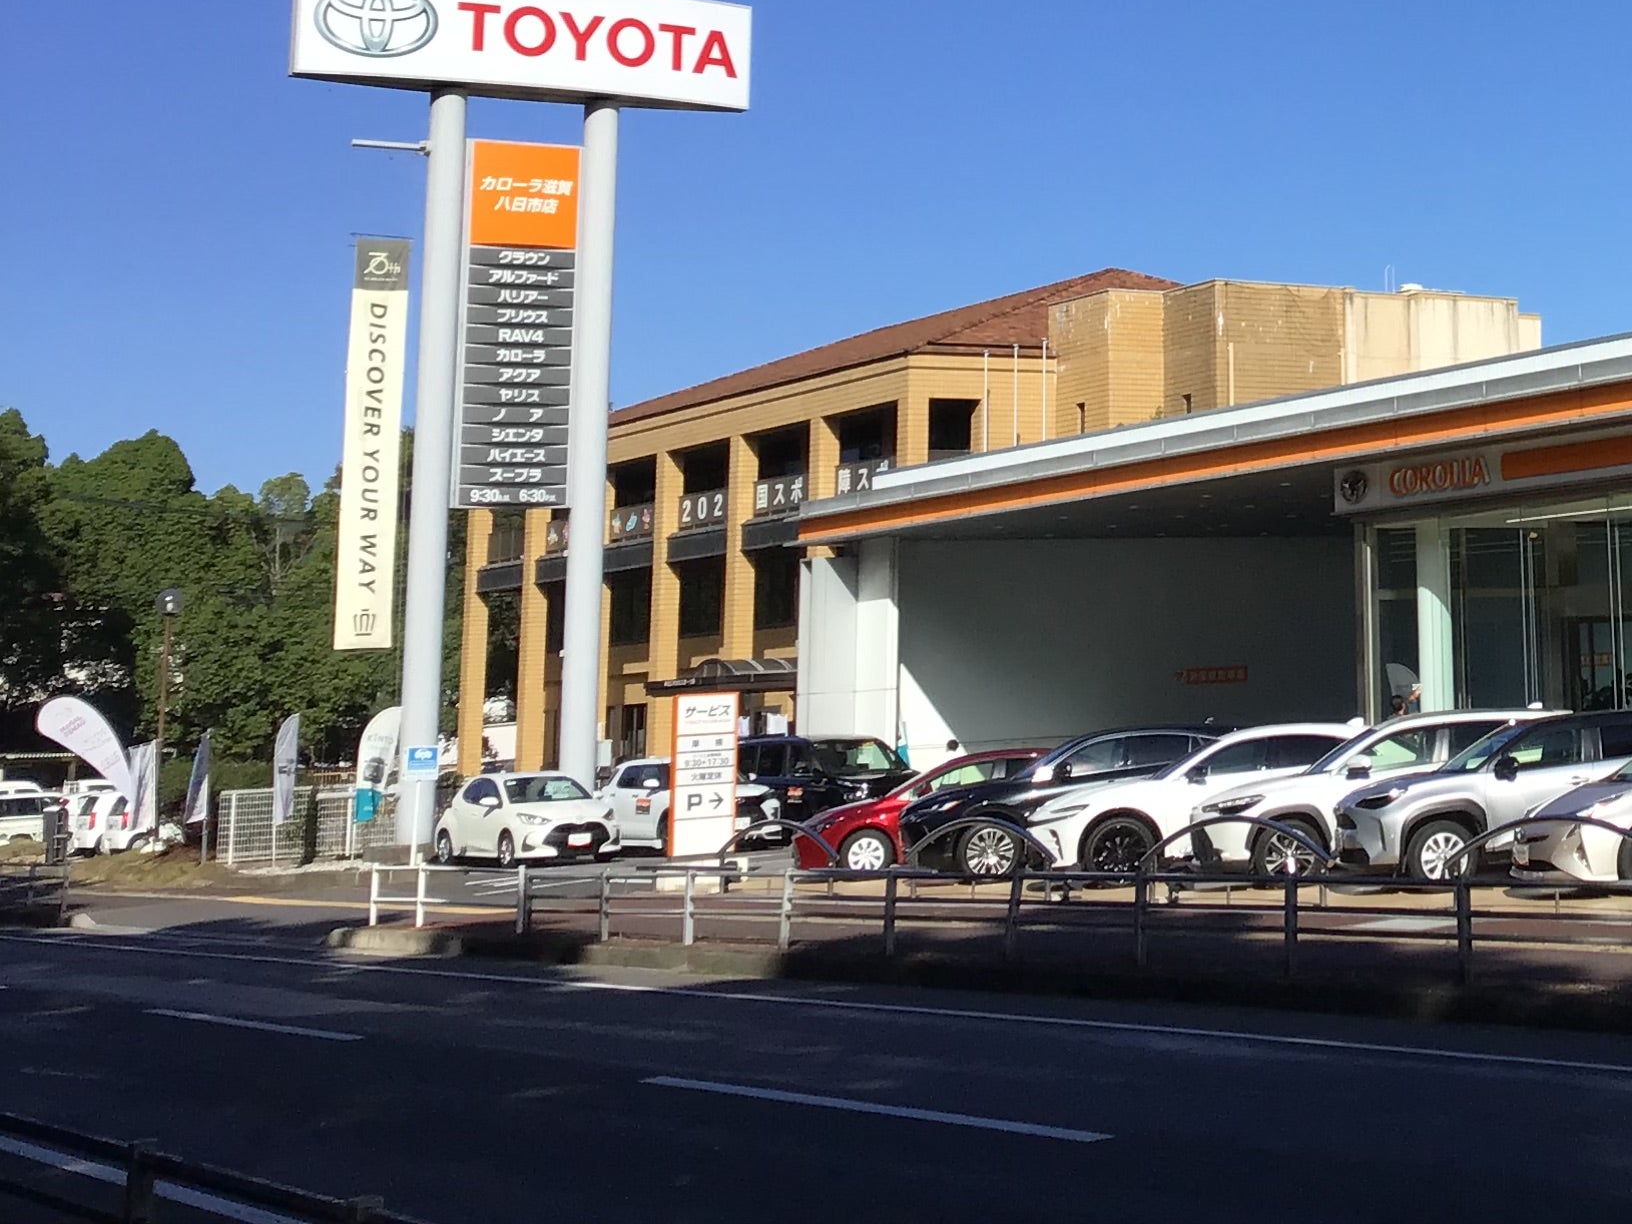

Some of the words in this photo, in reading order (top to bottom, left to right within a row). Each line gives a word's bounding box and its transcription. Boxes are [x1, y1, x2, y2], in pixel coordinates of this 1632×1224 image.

[458, 2, 737, 79] TOYOTA
[480, 176, 573, 196] カローラ滋賀
[494, 196, 559, 214] 八日市店
[499, 251, 550, 265] クラウン
[488, 270, 559, 284] アルファード
[497, 289, 548, 303] ハリアー
[497, 309, 548, 323] プリウス
[498, 329, 544, 343] RAV4
[496, 350, 545, 363] カローラ
[363, 302, 388, 437] DISCOVER
[499, 368, 541, 382] アクア
[499, 389, 539, 402] ヤリス
[492, 409, 543, 422] ノア
[492, 428, 543, 442] シエンタ
[487, 449, 545, 462] ハイエース
[489, 468, 541, 482] スープラ
[1389, 455, 1490, 497] COROLLA
[360, 449, 380, 521] YOUR
[756, 475, 803, 510] 国スポ
[358, 534, 377, 594] WAY
[685, 705, 731, 718] サービス
[687, 794, 702, 811] P
